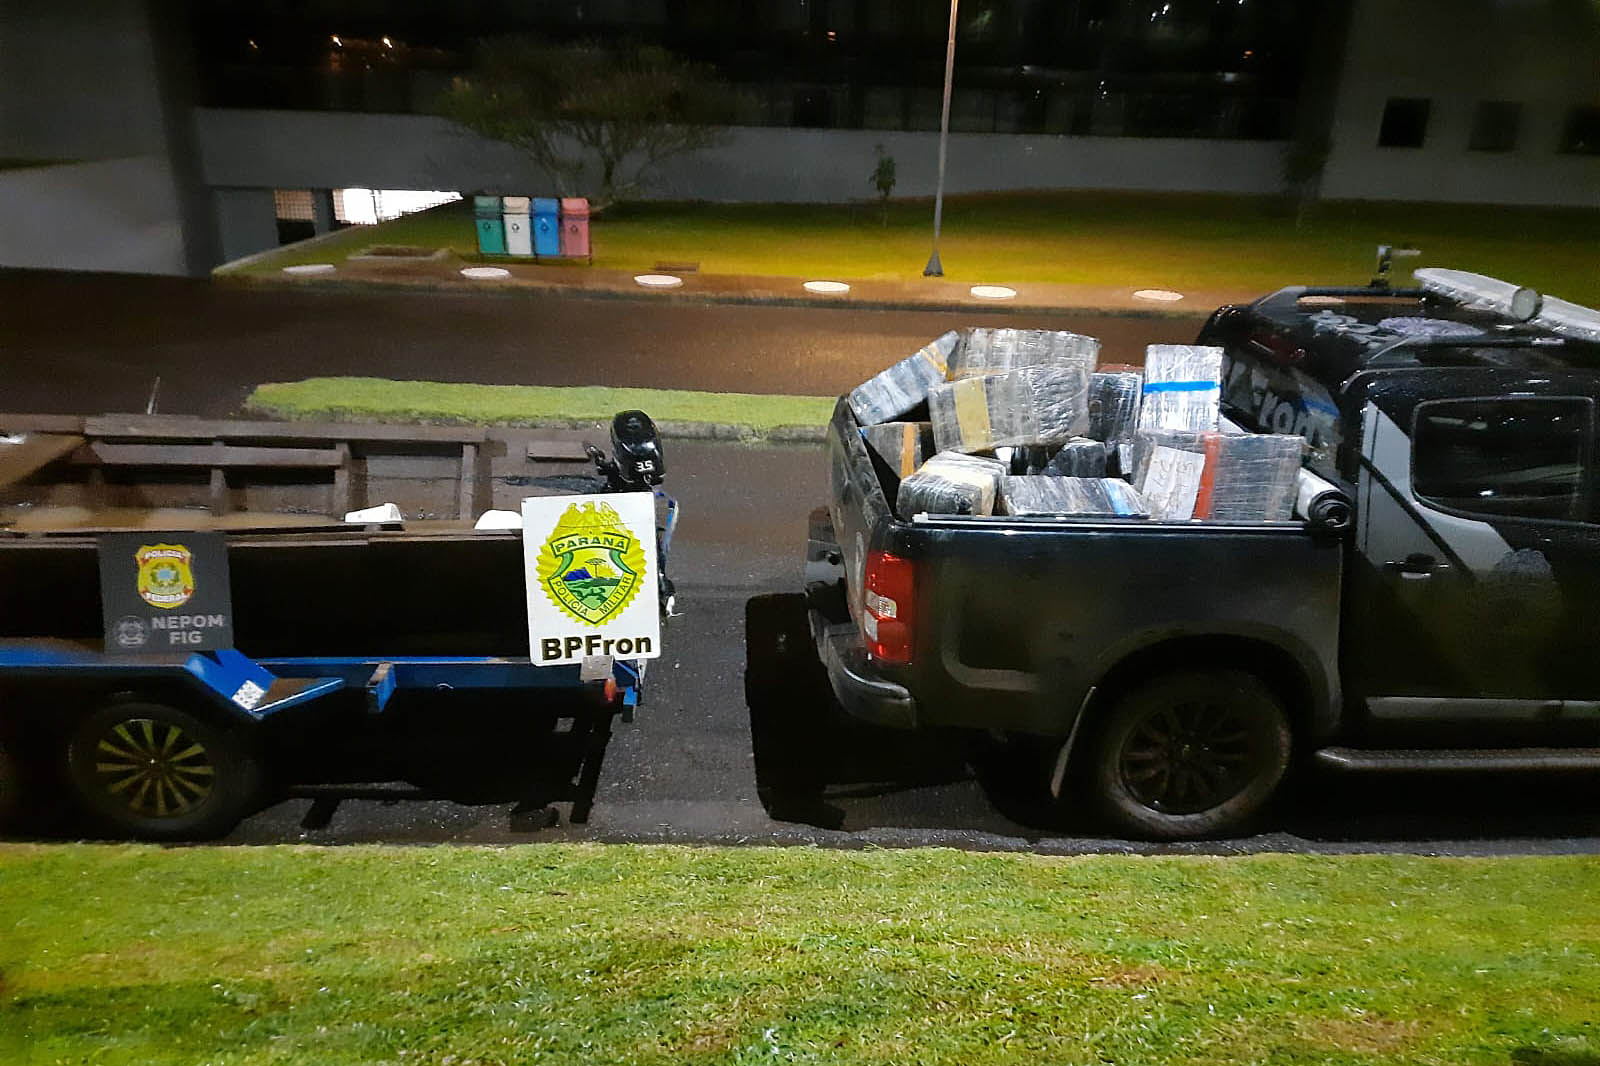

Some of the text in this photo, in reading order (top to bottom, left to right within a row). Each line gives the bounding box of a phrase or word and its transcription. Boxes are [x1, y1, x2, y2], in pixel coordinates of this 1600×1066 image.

[599, 575, 632, 615] MILITAR
[151, 614, 225, 630] NEPOM
[169, 630, 203, 645] FIG
[541, 634, 653, 661] BPFron
